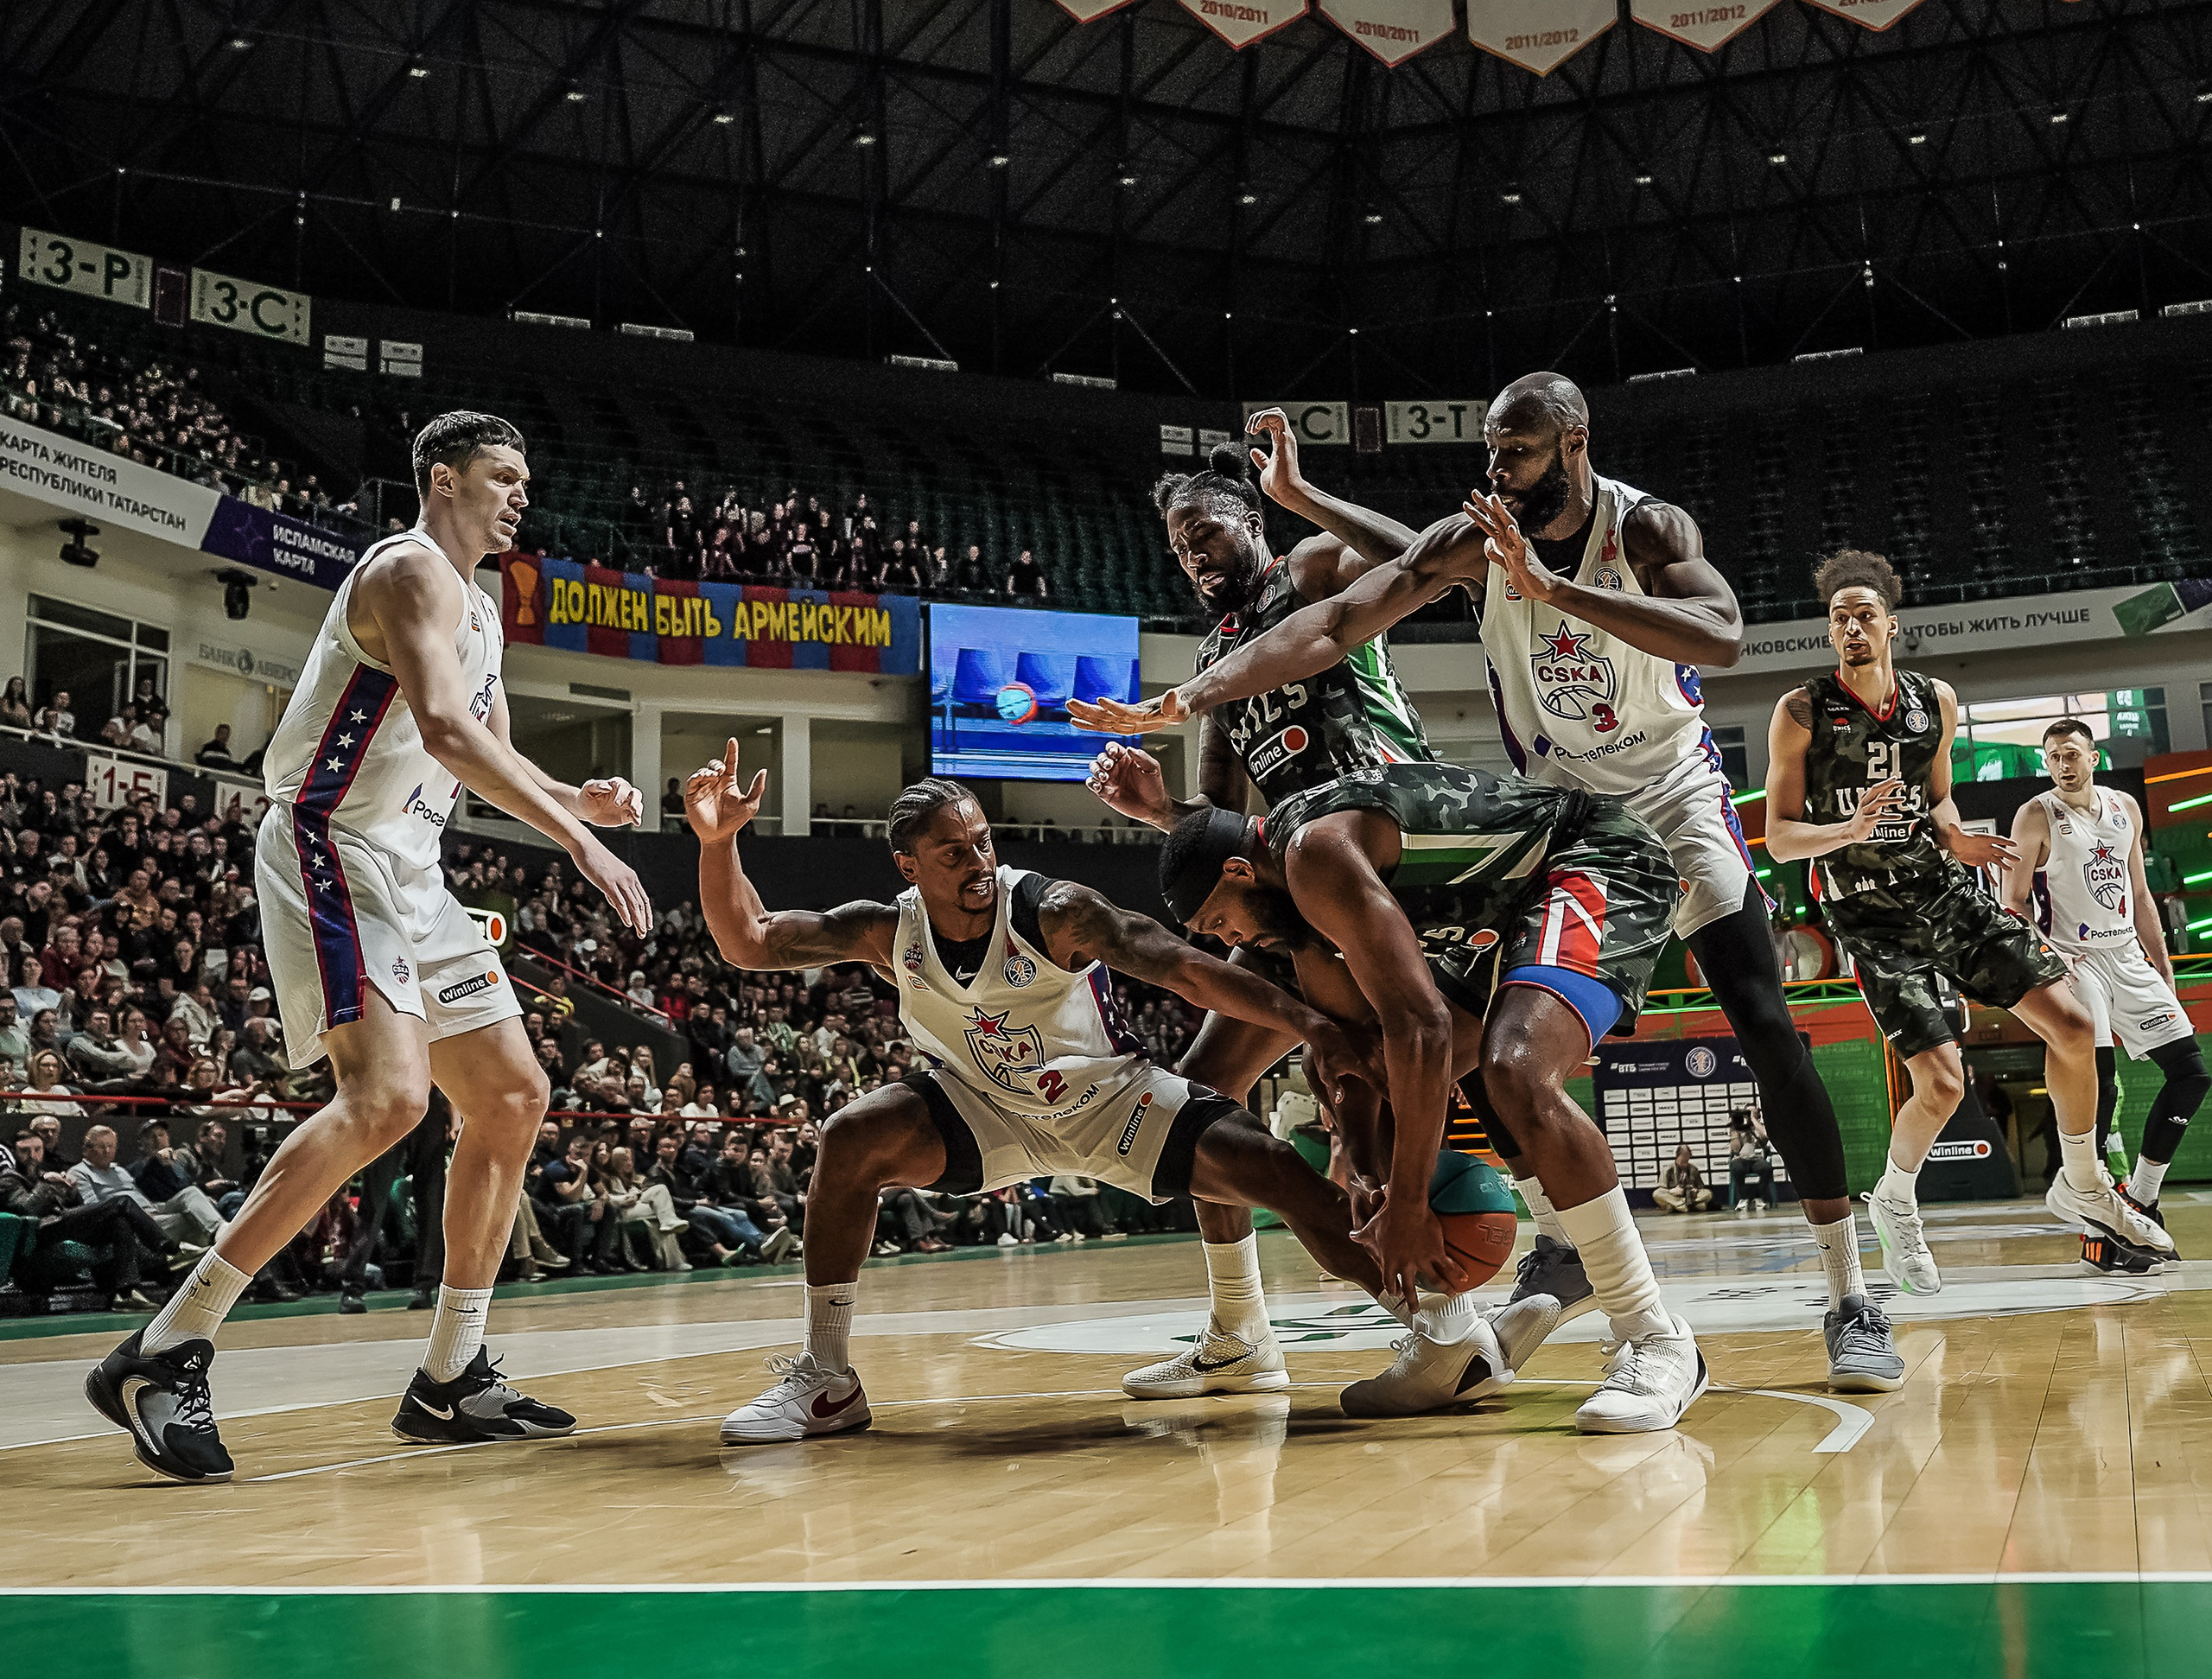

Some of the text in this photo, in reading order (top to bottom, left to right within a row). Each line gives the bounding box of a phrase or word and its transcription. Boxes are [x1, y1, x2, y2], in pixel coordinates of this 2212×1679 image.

[1670, 4, 1745, 28] 2011/2012
[1505, 29, 1579, 50] 2011/2012
[0, 433, 118, 485] КАРТА ЖИТЕЛЯ
[0, 455, 187, 531] РЕСПУБЛИКИ ТАТАРСТАН
[273, 547, 315, 576] КАРТА
[550, 577, 892, 648] ДОЛЖЕН БЫТЬ АРМЕЙСКИМ
[1740, 635, 1830, 657] НКОВСКИЕ
[1903, 619, 1964, 639] ЧТОБЫ
[1968, 614, 2020, 633] ЖИТЬ
[2024, 607, 2091, 628] ЛУЧШЕ
[1538, 665, 1605, 684] CSKA
[1592, 703, 1619, 733] 3
[1251, 746, 1282, 775] inline
[1867, 741, 1902, 779] 21
[2090, 867, 2123, 881] CSKA
[2117, 894, 2127, 919] 4
[906, 951, 922, 960] CSKA
[441, 978, 486, 1002] Winline
[2141, 1016, 2167, 1029] Winline
[1037, 1069, 1070, 1105] 2
[1119, 1108, 1145, 1152] Winline
[1930, 1145, 1973, 1157] Winline
